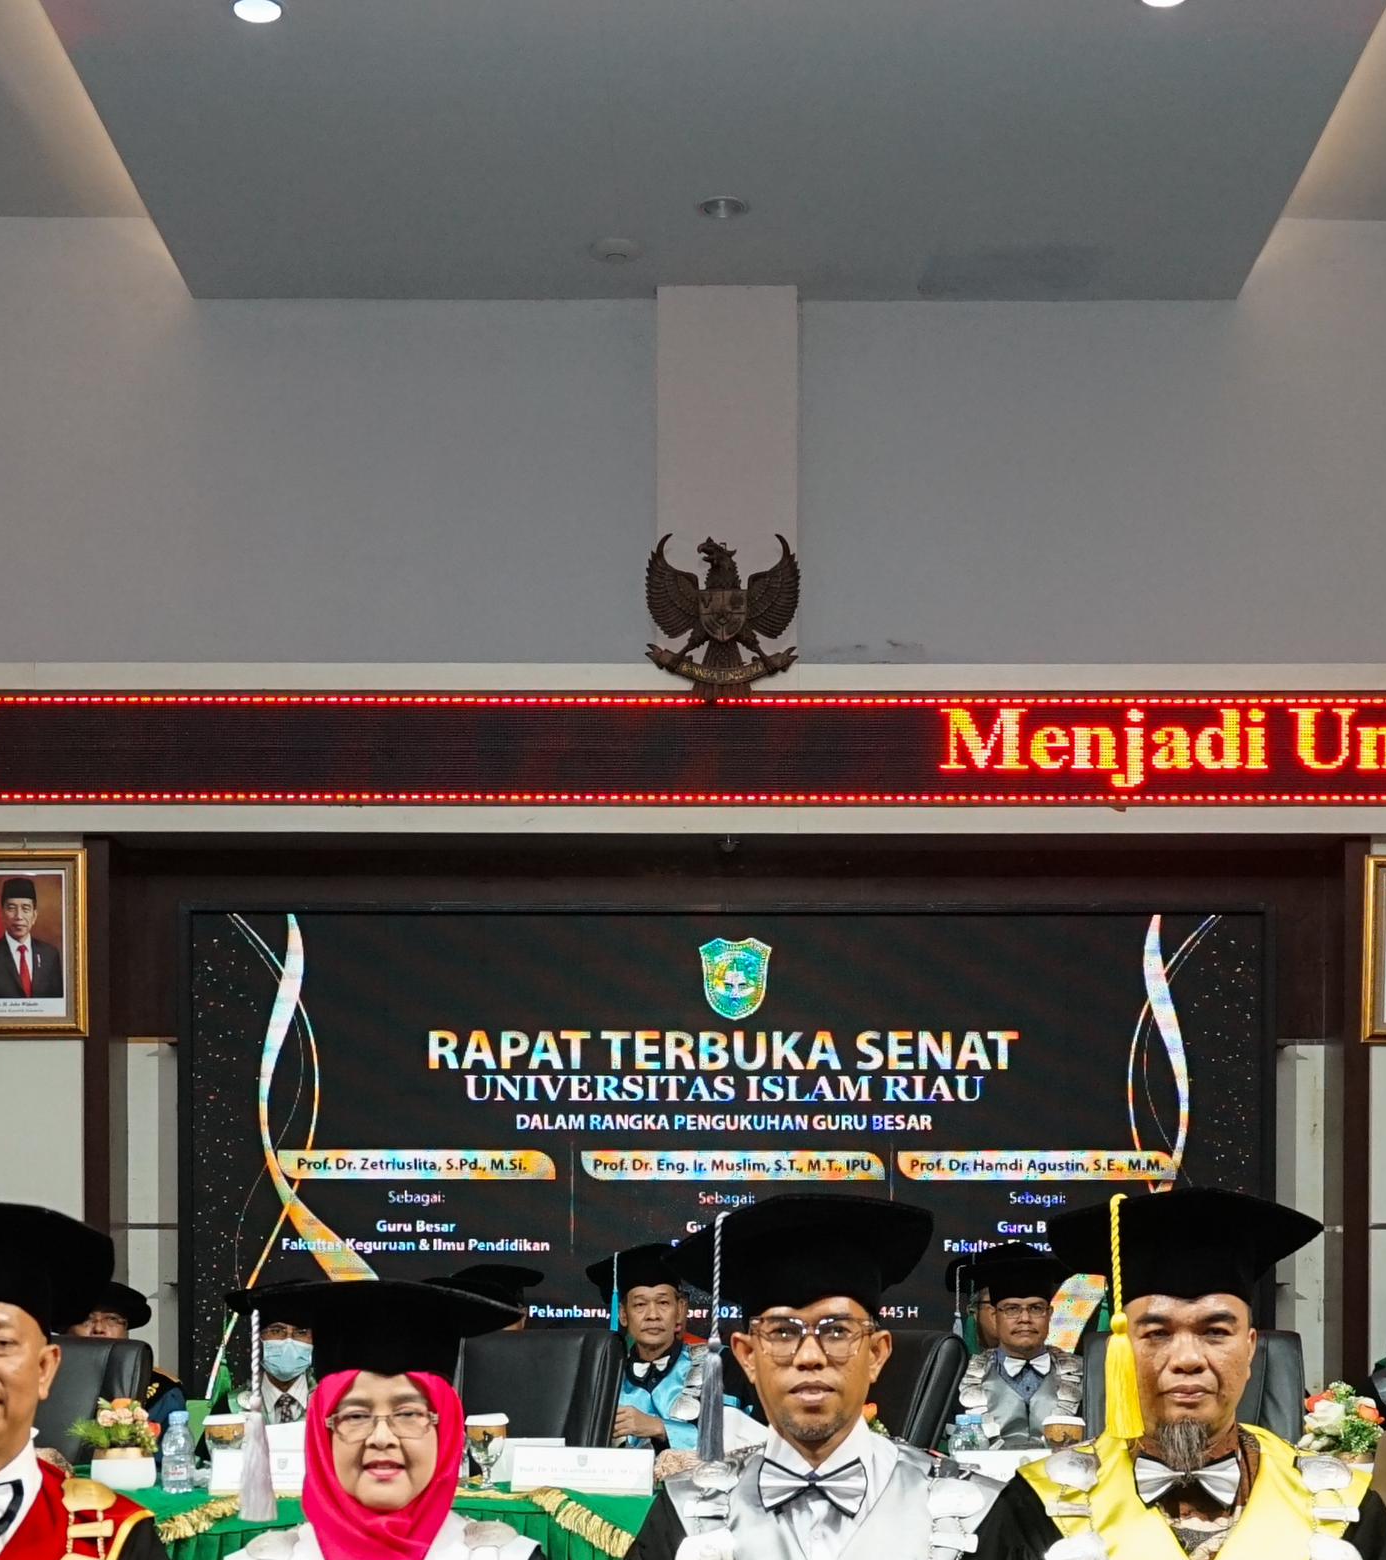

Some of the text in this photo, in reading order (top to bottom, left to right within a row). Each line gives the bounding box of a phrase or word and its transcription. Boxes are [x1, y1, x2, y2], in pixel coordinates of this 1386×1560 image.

[939, 707, 1268, 787] Menjadi
[428, 1030, 1020, 1071] RAPAT TERBUKA SENAT
[465, 1075, 984, 1102] UNIVERSITAS ISLAM RIAU
[515, 1114, 933, 1131] DALAM RANGKA PENGUKUHAN GURU BESAR
[297, 1158, 331, 1171] Prof.
[335, 1158, 356, 1171] Dr.
[491, 1158, 527, 1171] M.Si.
[593, 1158, 628, 1172] Prof.
[633, 1159, 653, 1172] Dr.
[656, 1159, 689, 1174] Eng.
[694, 1159, 707, 1172] Ir.
[711, 1159, 770, 1173] Muslim,
[846, 1159, 872, 1172] IPU
[910, 1158, 945, 1172] Prof.
[949, 1159, 969, 1172] Dr.
[973, 1159, 1023, 1172] Hamdi
[1027, 1159, 1090, 1175] Agustin,
[1127, 1159, 1166, 1172] M.M.
[388, 1190, 446, 1207] Sebagai:
[698, 1191, 756, 1207] Sebagai:
[1009, 1191, 1066, 1207] Sebagai:
[376, 1219, 457, 1233] Guru Besar
[997, 1220, 1033, 1234] Guru
[345, 1238, 415, 1254] Keguruan
[419, 1238, 430, 1251] &
[433, 1238, 464, 1251] Ilmu
[468, 1238, 550, 1251] Pendidikan
[943, 1238, 1004, 1253] Fakulta
[528, 1304, 610, 1321] Pekanbaru,
[907, 1305, 919, 1319] H
